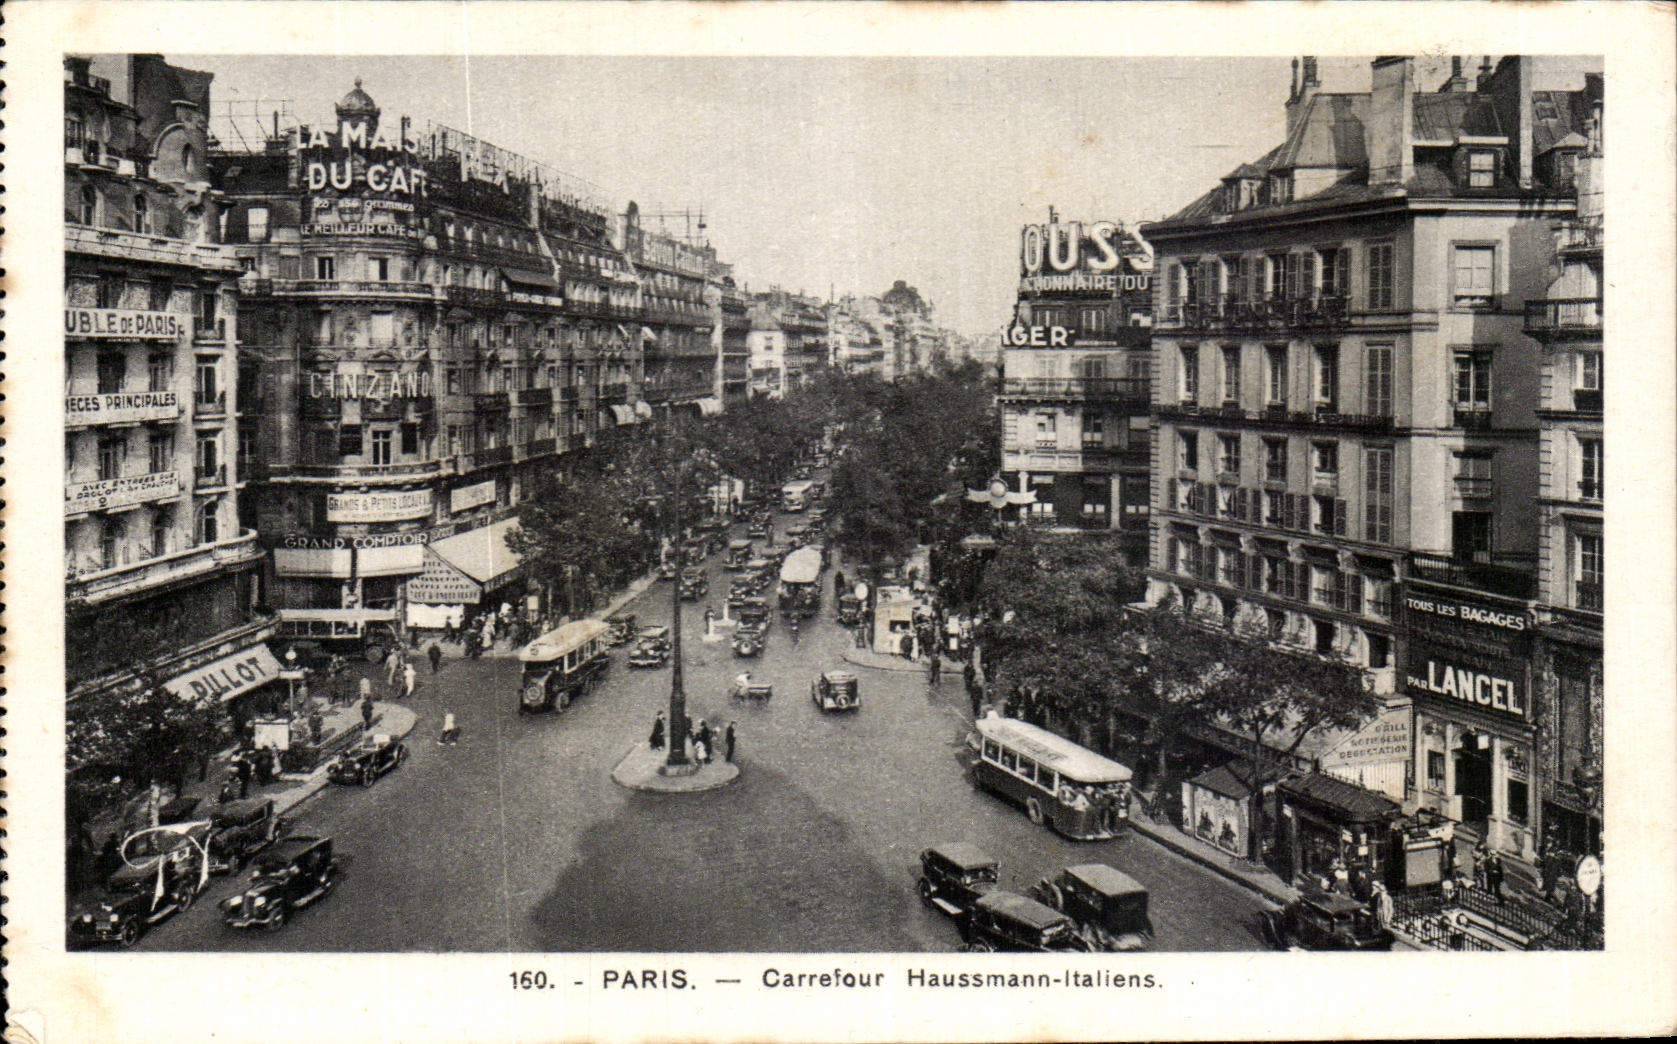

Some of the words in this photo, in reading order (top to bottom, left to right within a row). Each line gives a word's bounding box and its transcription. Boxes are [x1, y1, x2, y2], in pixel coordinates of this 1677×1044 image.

[296, 125, 330, 149] LA
[308, 162, 352, 190] DU
[314, 222, 375, 236] MEILLEUR
[1125, 276, 1149, 291] DU
[65, 310, 117, 334] UBLE
[121, 317, 133, 334] DE
[136, 314, 177, 335] PARIS
[310, 371, 430, 400] CINZANO
[106, 393, 177, 410] PRINCIPALES
[284, 536, 345, 549] GRAND
[353, 533, 428, 549] COMPTOIR
[1407, 598, 1434, 612] TOUS
[1437, 604, 1456, 617] LES
[1460, 605, 1525, 631] BAGAGES
[1407, 675, 1428, 690] PAR
[1428, 660, 1524, 716] LANCEL
